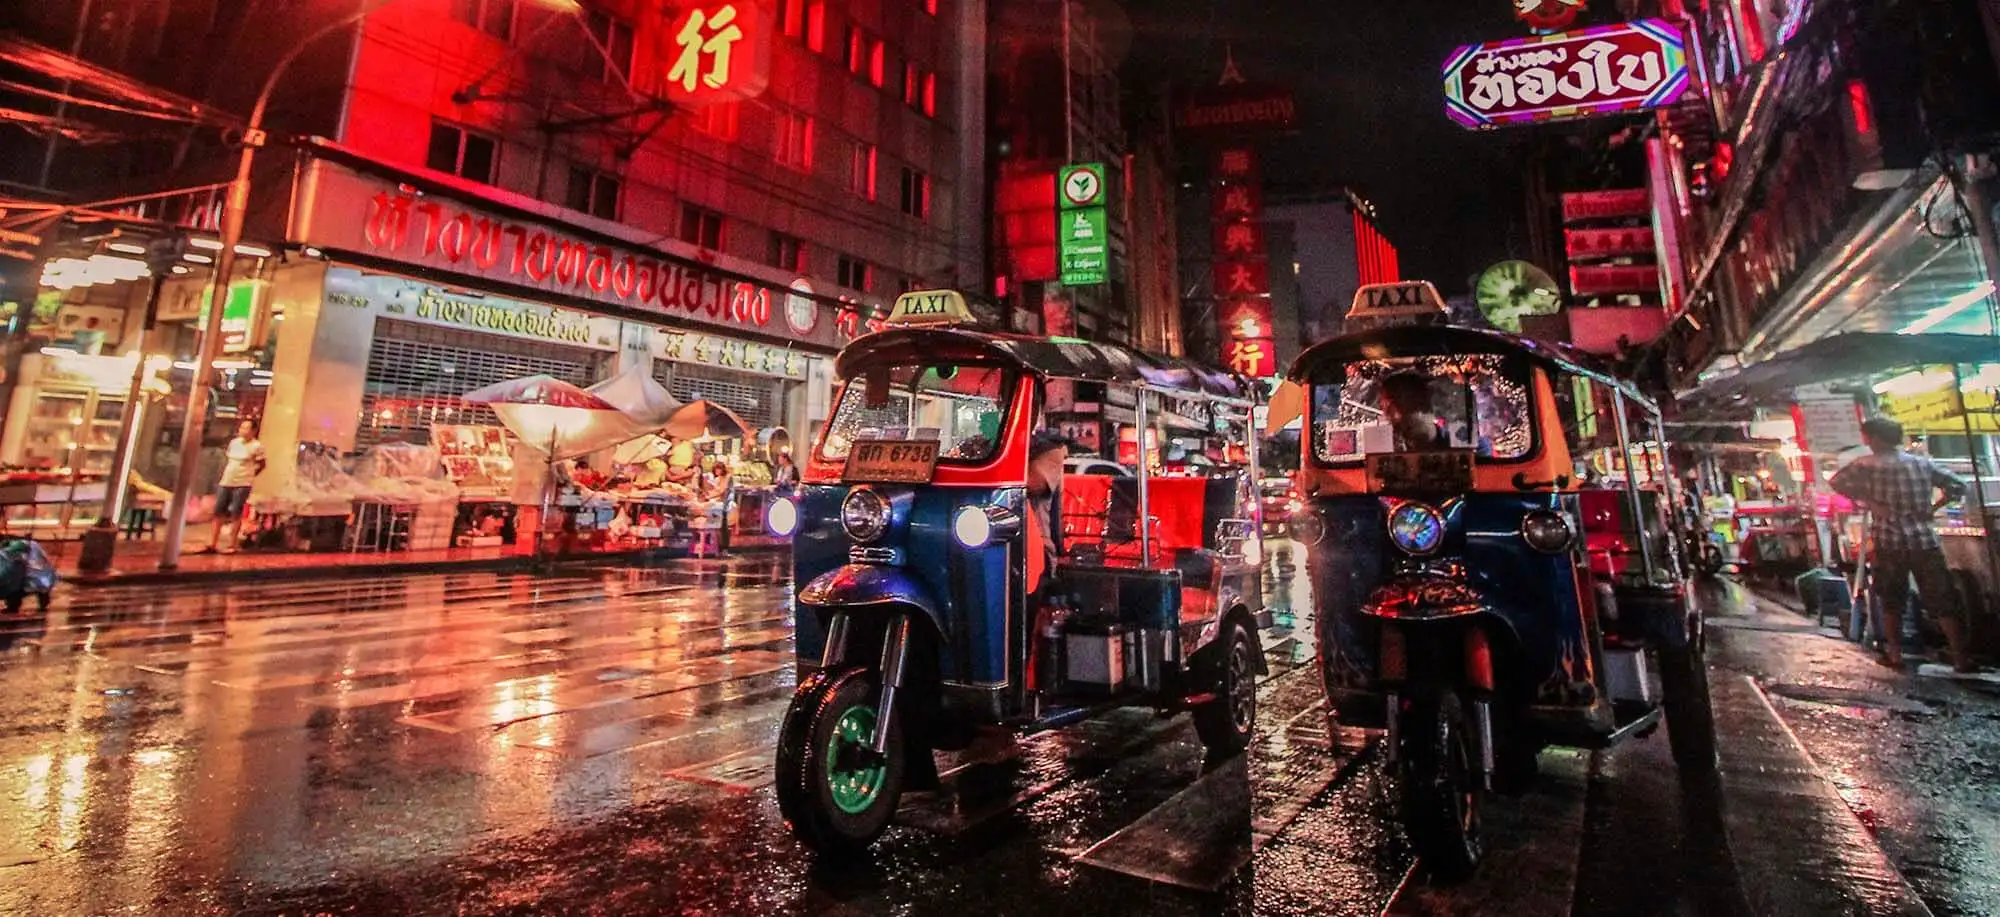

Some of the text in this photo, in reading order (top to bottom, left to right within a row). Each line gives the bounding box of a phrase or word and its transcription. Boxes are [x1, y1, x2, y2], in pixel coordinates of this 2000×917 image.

[667, 4, 744, 93] 行
[1468, 40, 1662, 110] ทองใบ
[903, 294, 948, 315] TAXI
[1362, 285, 1424, 308] TAXI
[890, 444, 933, 463] 6738
